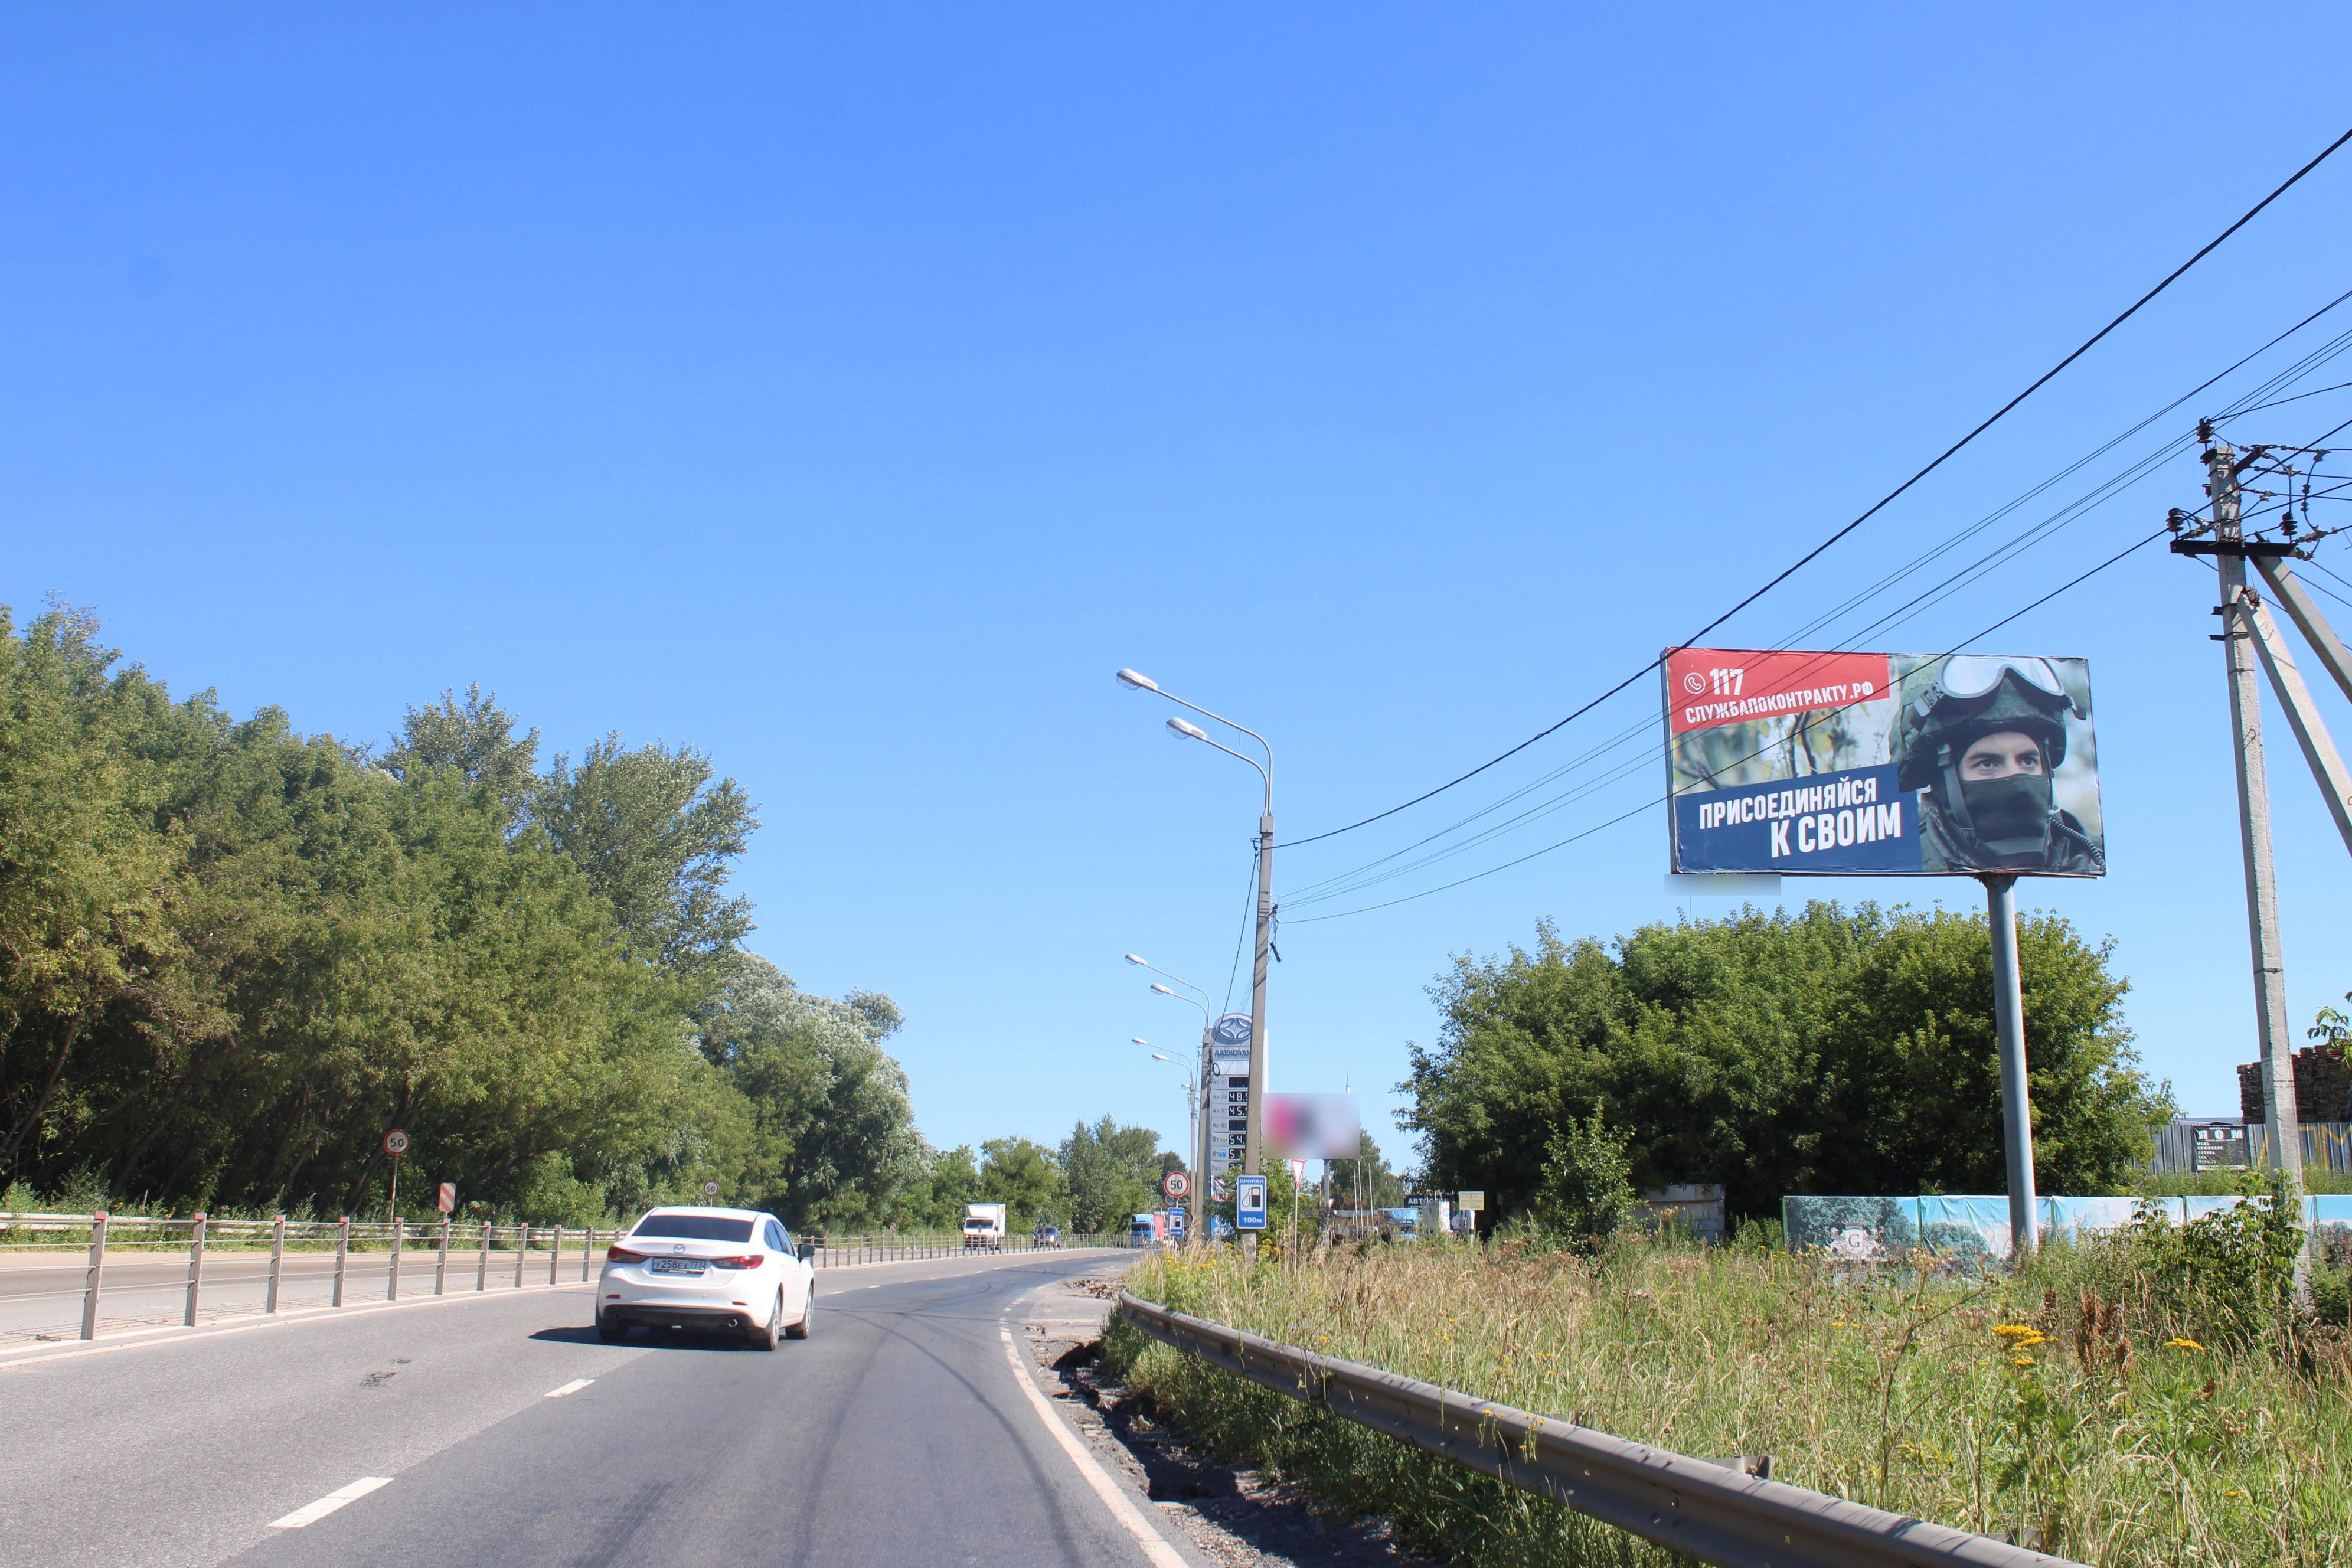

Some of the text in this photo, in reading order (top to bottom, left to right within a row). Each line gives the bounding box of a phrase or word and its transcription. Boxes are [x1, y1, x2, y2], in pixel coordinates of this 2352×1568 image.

[1710, 668, 1744, 695] 117
[1685, 681, 1874, 723] СЛУЖБАПОКОНТРАКТУ.РФ
[1700, 776, 1877, 829] ПРИСОЕДИНЯЙСЯ
[1771, 802, 1901, 858] К СВОИМ
[1230, 1106, 1247, 1115] 45.
[2198, 1129, 2243, 1139] ЛОМ
[390, 1138, 404, 1148] 50
[1171, 1180, 1182, 1190] 50
[1848, 1234, 1860, 1247] G
